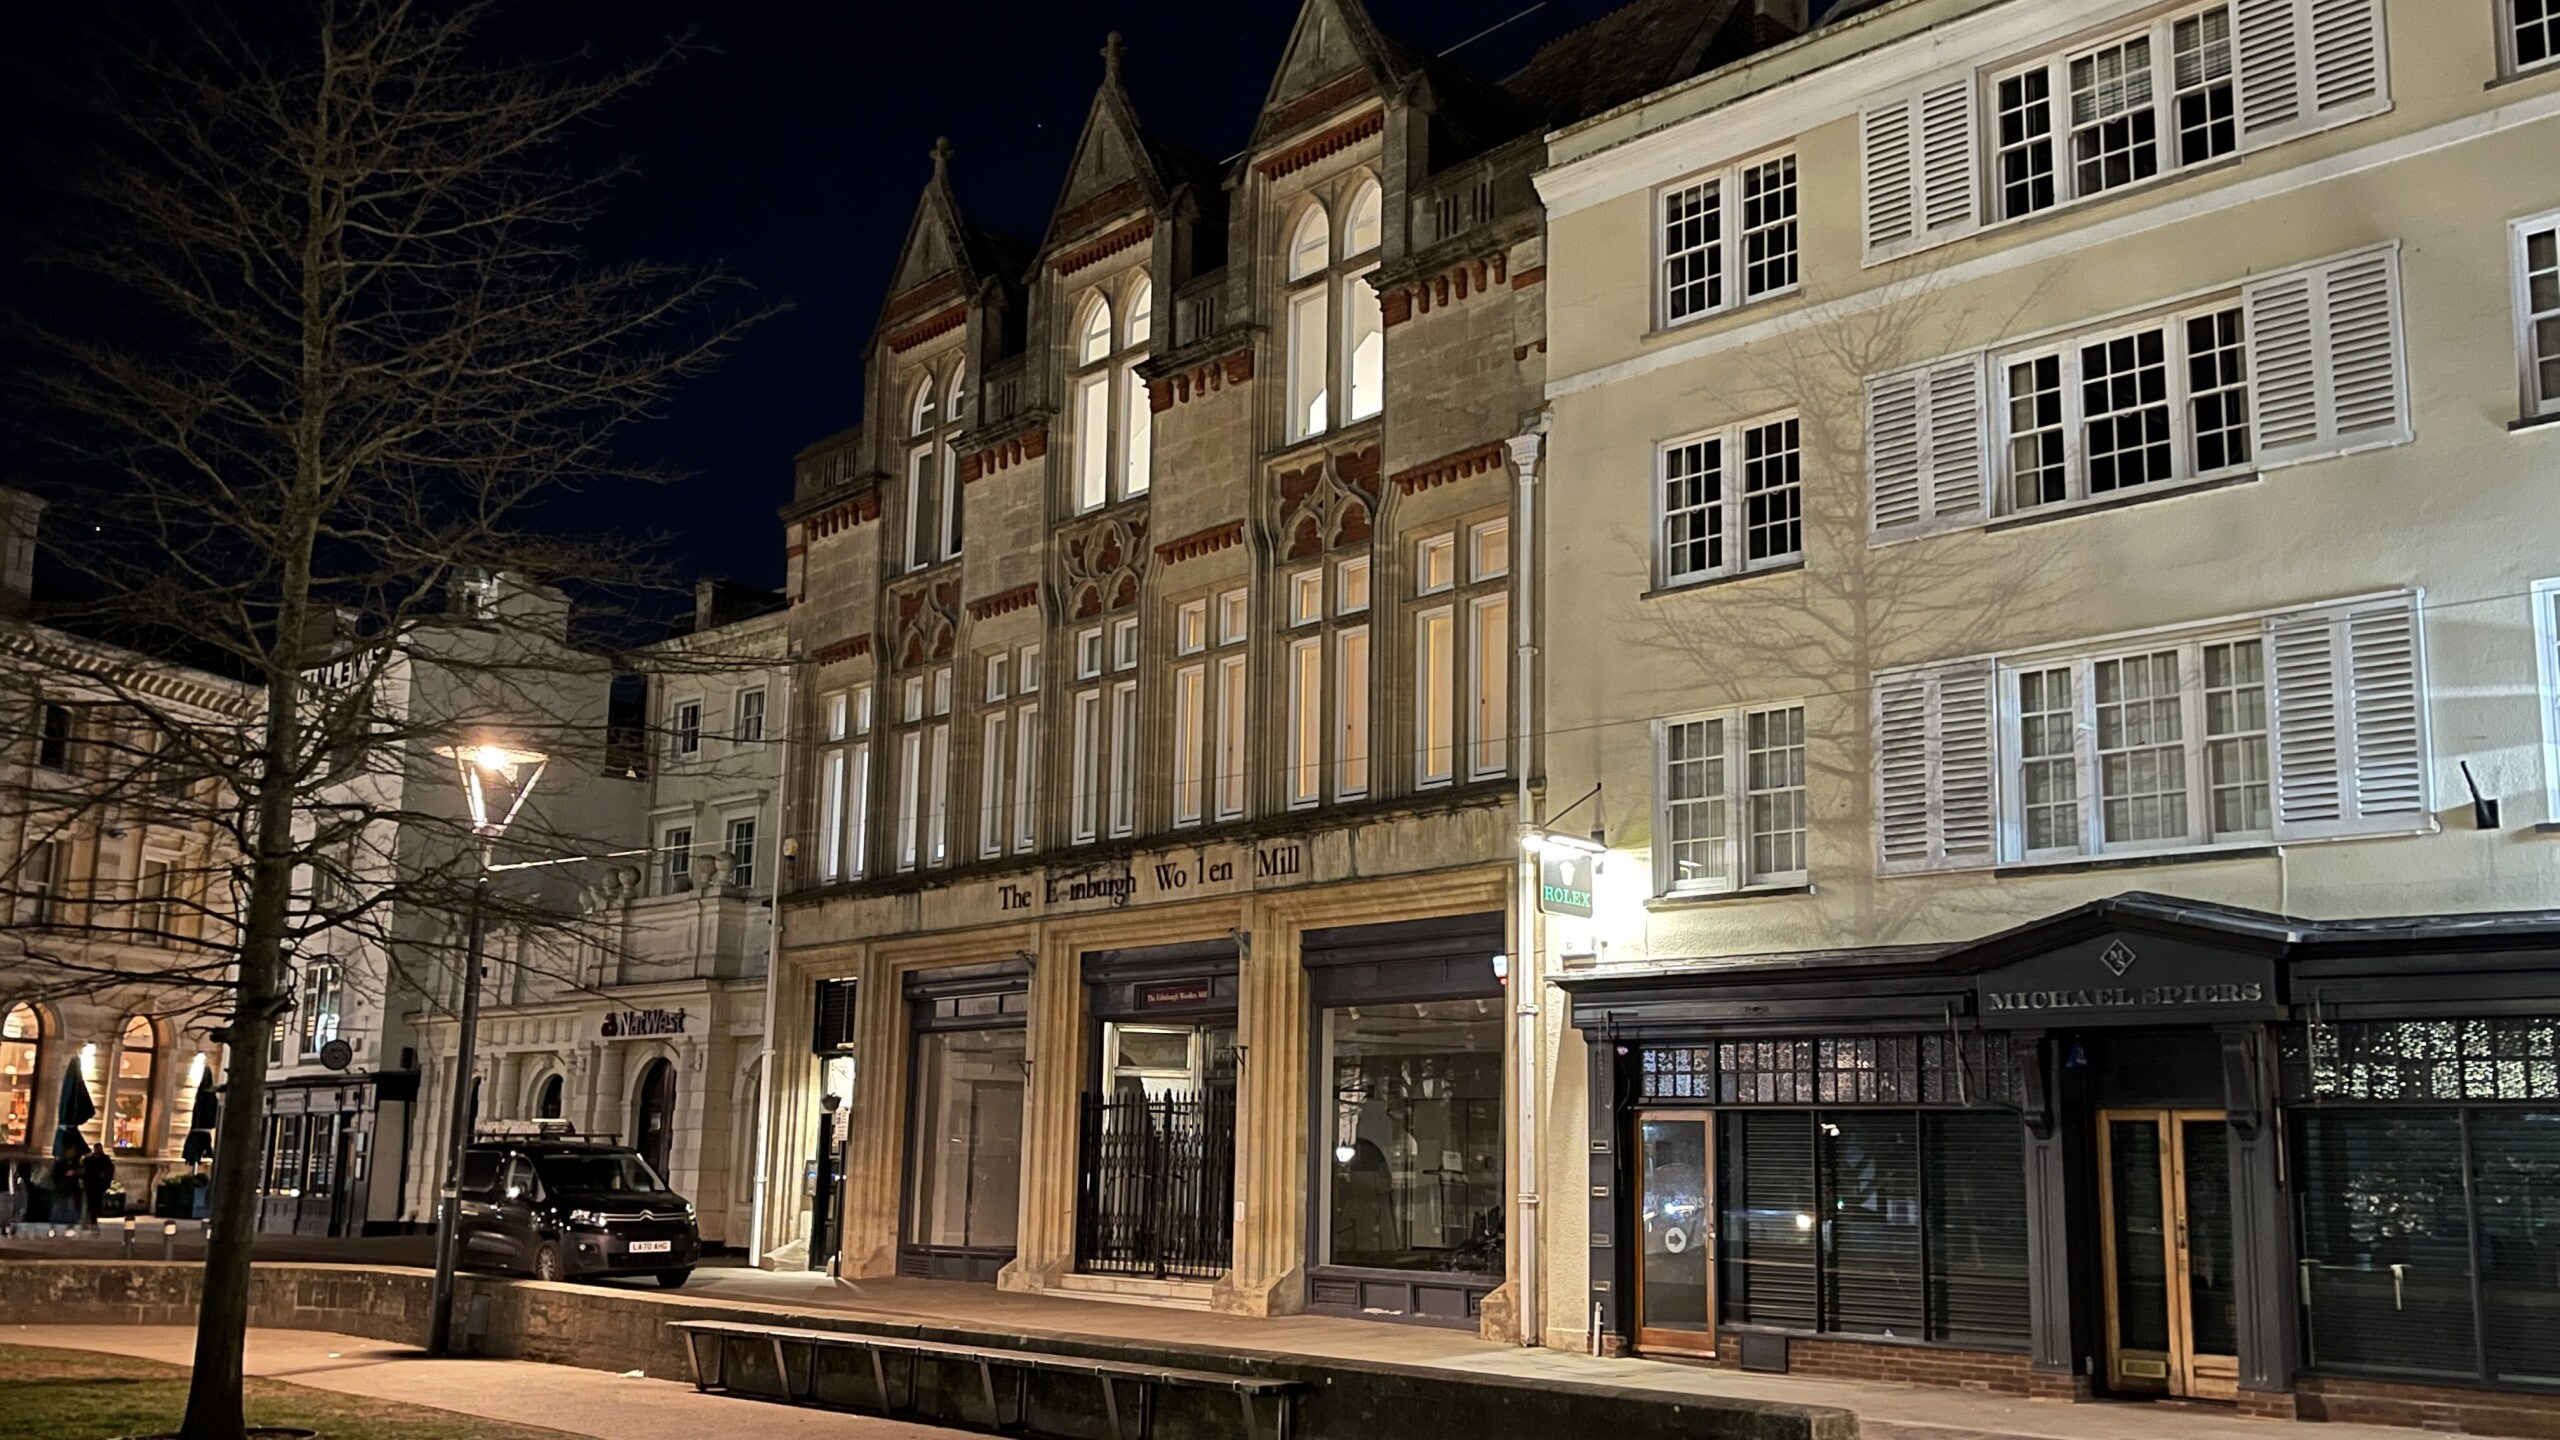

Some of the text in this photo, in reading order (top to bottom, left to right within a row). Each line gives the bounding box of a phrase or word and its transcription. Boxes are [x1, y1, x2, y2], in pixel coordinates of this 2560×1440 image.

[998, 884, 1031, 910] The
[1045, 867, 1137, 905] Einburgh
[1257, 845, 1299, 878] Mill
[1544, 885, 1591, 908] ROLEX
[1988, 982, 2263, 1011] MICHAEL SPIERS
[621, 1008, 686, 1036] NatWest
[632, 1242, 667, 1251] LA70 AHG
